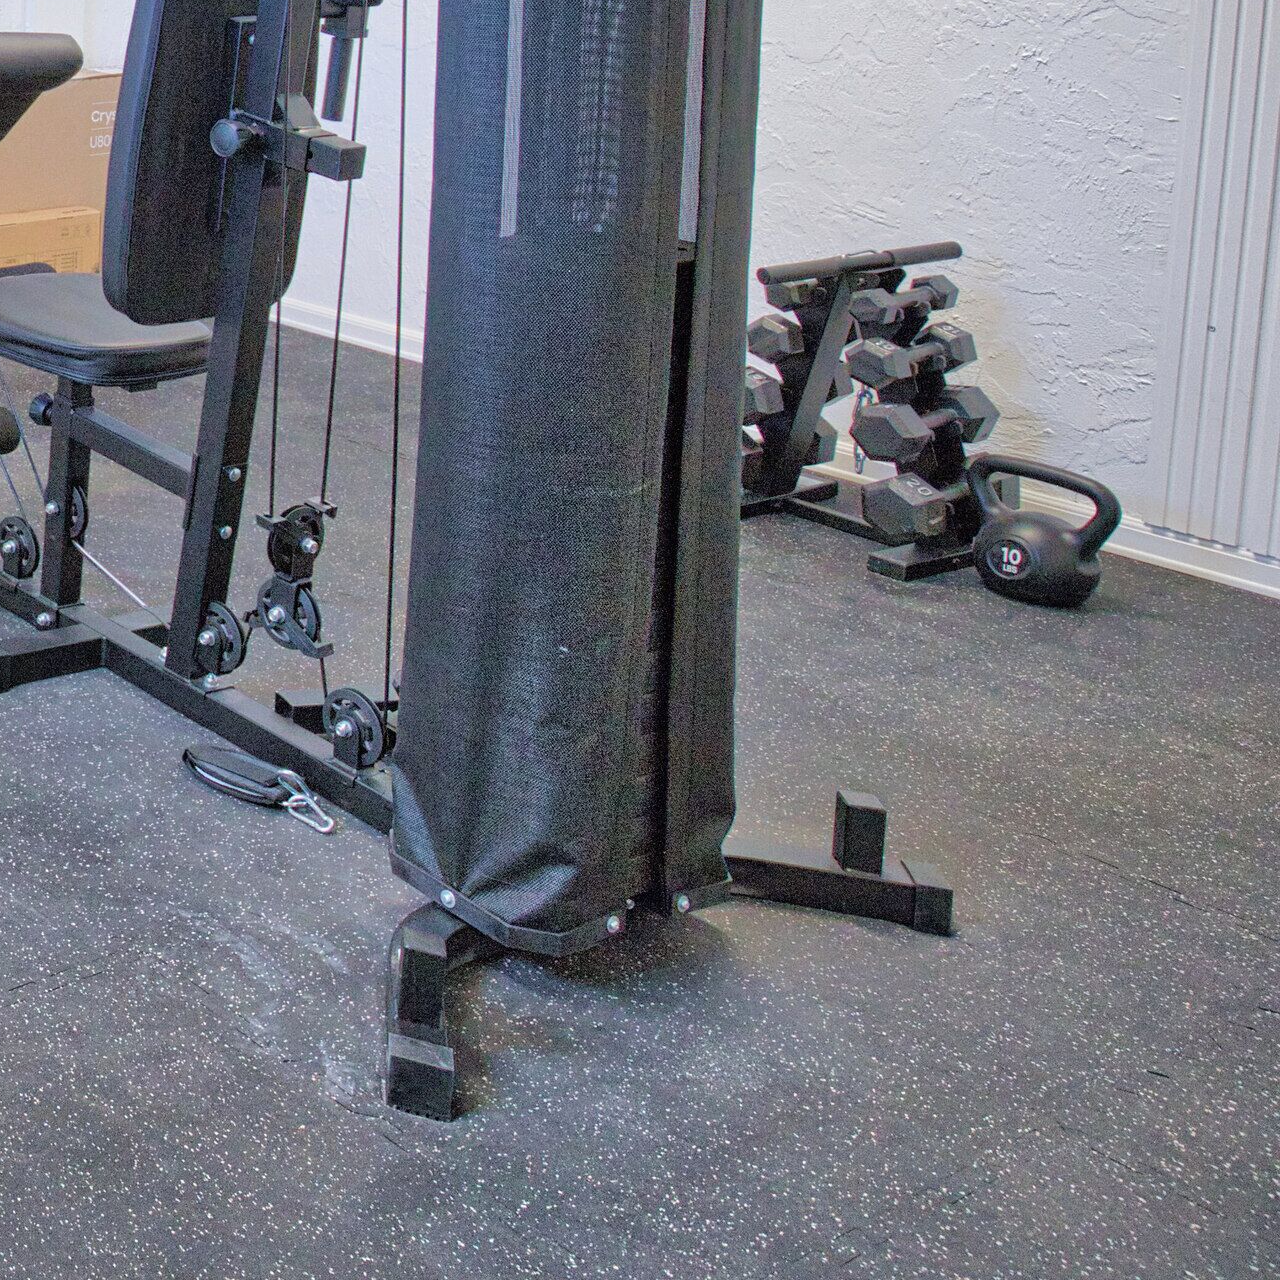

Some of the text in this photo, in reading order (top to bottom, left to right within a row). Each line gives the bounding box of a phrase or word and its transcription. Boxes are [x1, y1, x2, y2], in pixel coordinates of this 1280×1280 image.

[90, 134, 112, 148] U80
[907, 479, 932, 496] 20
[1001, 546, 1022, 565] 10
[1002, 564, 1018, 574] LBS
